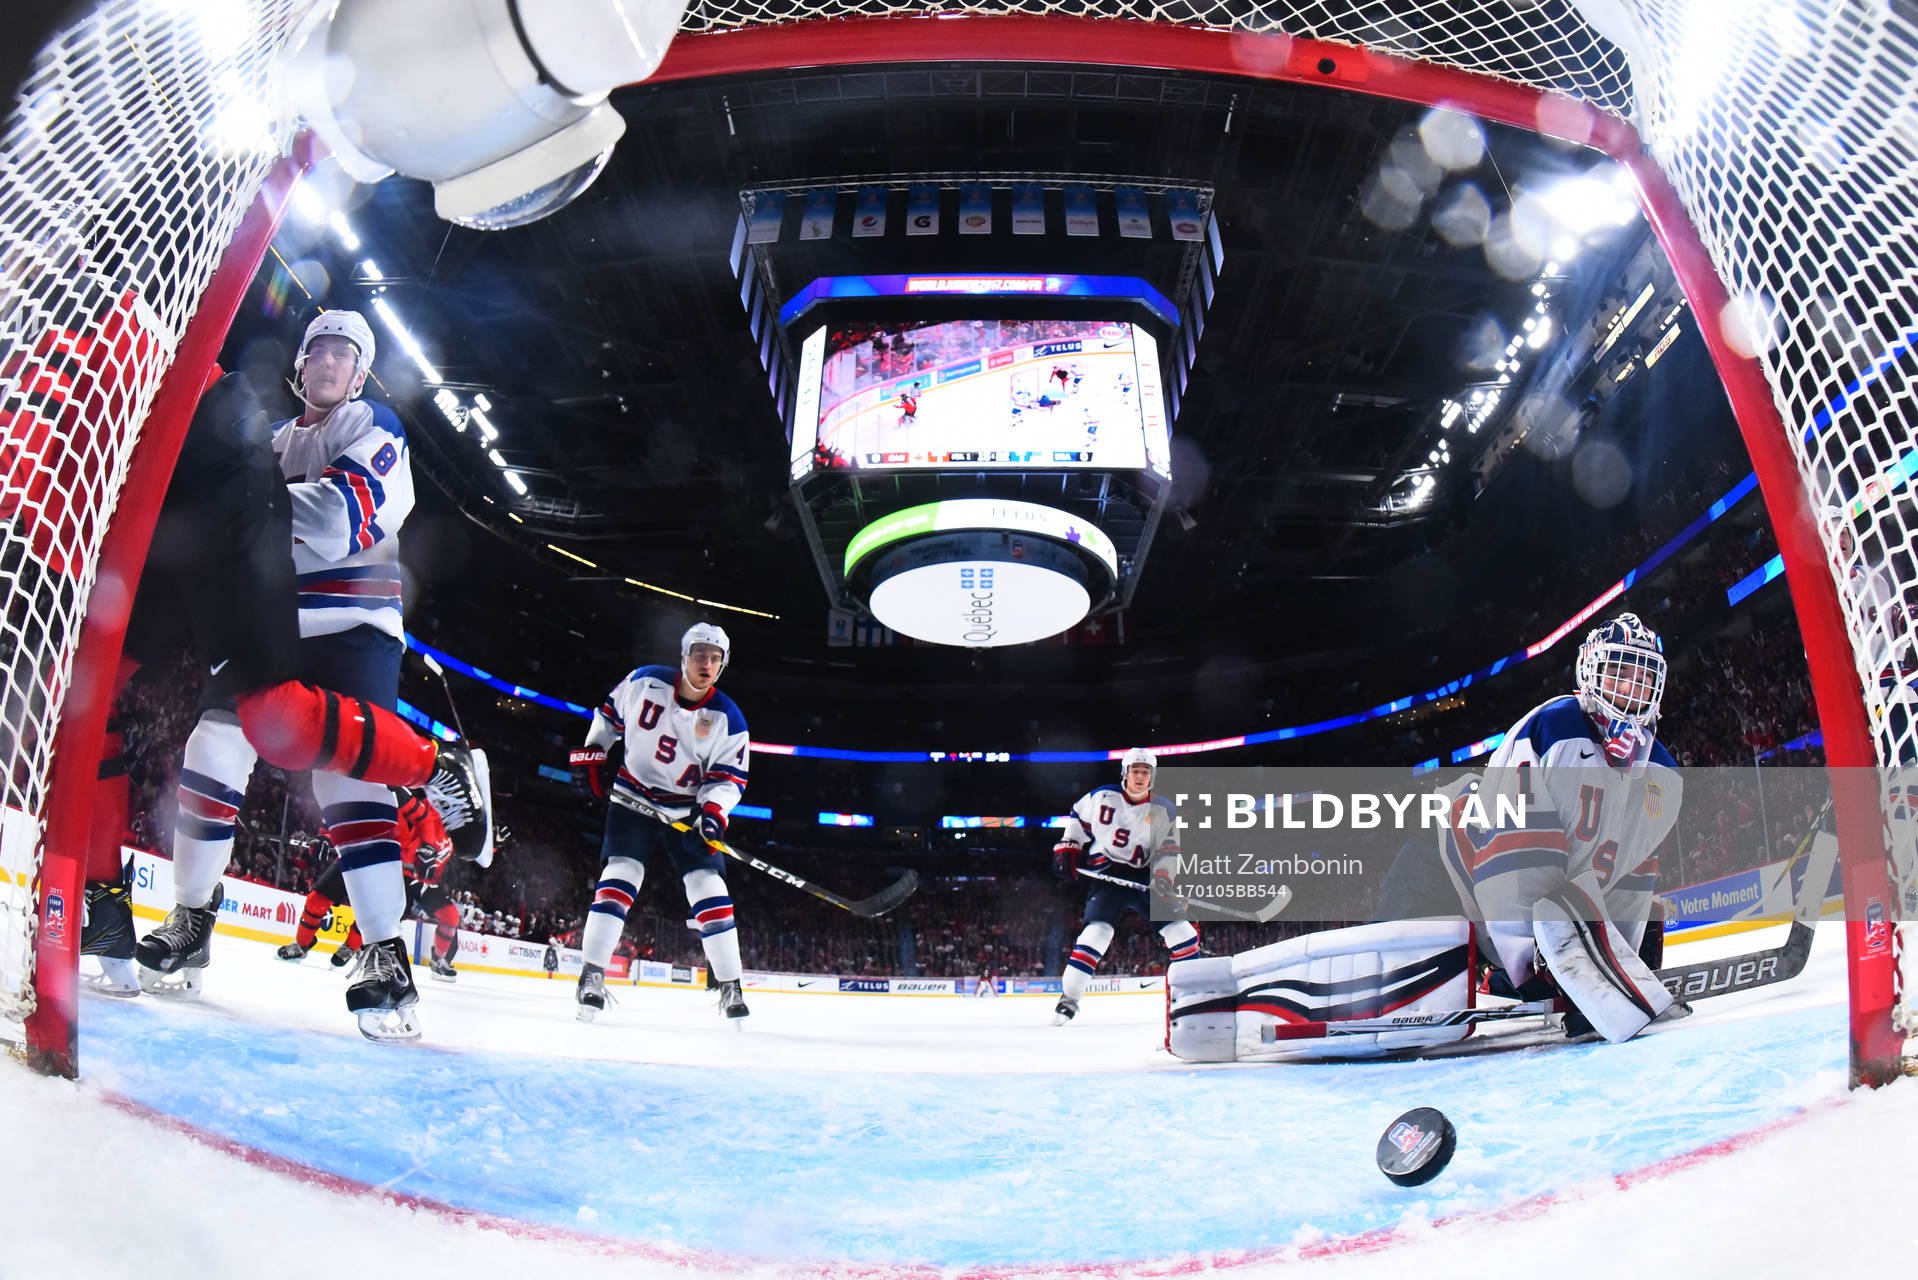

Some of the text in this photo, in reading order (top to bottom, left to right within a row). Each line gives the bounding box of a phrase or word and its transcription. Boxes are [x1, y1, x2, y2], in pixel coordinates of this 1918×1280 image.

[1050, 342, 1082, 352] TELUS
[371, 442, 397, 477] 8
[962, 592, 997, 642] Québec
[289, 838, 311, 848] CC
[750, 857, 807, 889] CCM
[1680, 881, 1760, 916] Votre Moment
[242, 902, 272, 921] MART
[335, 915, 349, 935] Ex
[457, 936, 479, 952] NADA
[518, 946, 542, 960] TISSOT
[858, 980, 889, 991] TELUS
[1660, 955, 1778, 999] BAUER
[896, 982, 948, 991] BAUER
[1391, 1014, 1434, 1025] BAUER
